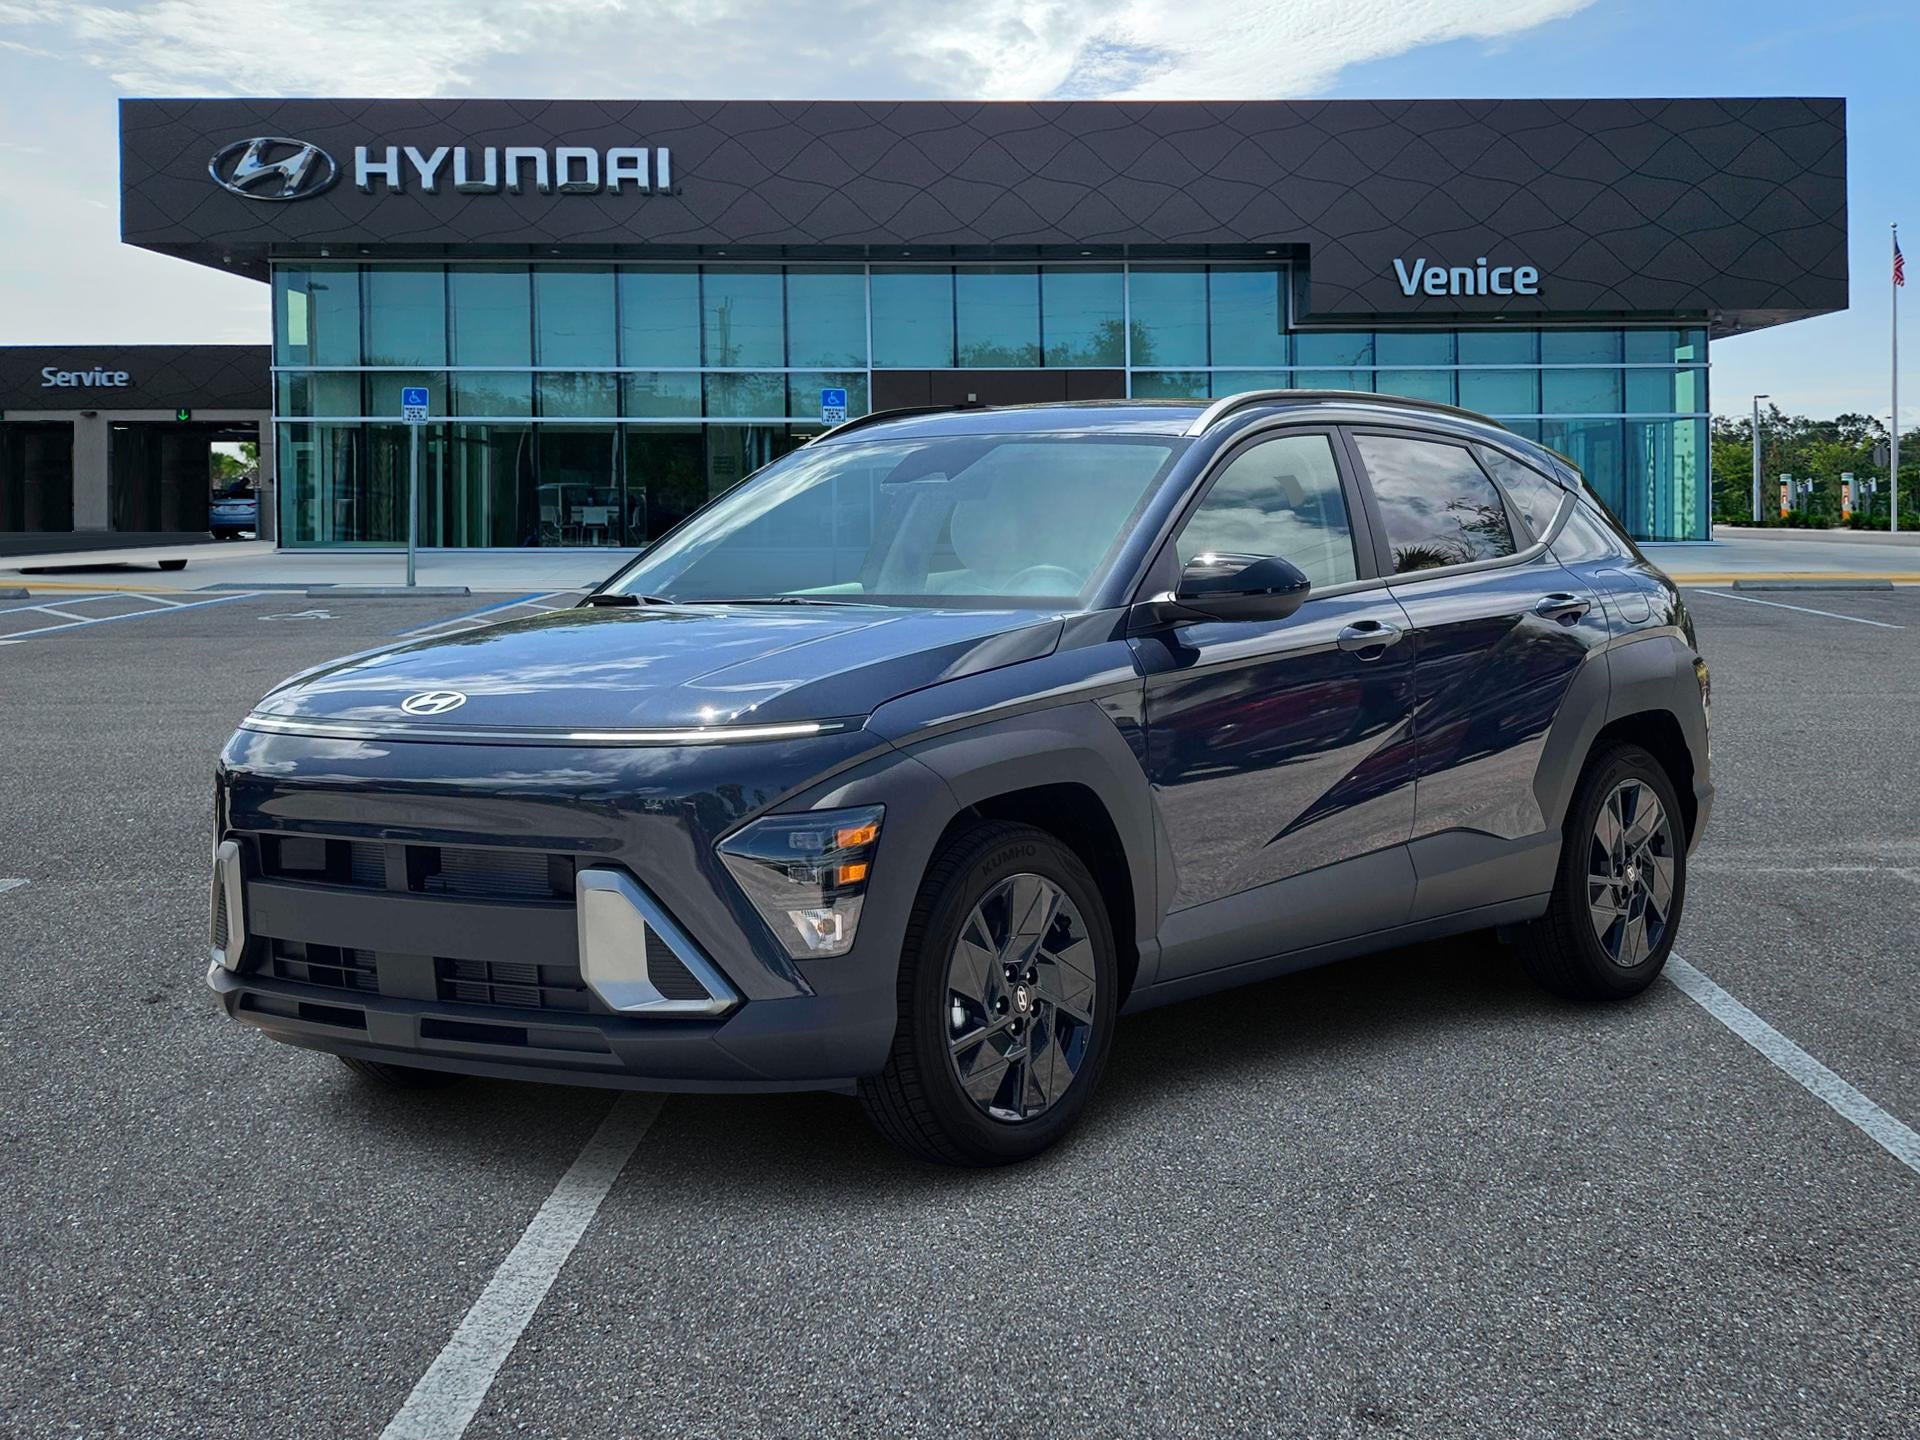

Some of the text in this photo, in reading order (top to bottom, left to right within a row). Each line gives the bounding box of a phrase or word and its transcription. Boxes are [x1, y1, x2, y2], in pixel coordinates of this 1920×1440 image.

[354, 146, 673, 194] HYUNDAI
[1393, 257, 1539, 296] Venice
[41, 367, 129, 387] Service
[982, 845, 1036, 876] KUMHO
